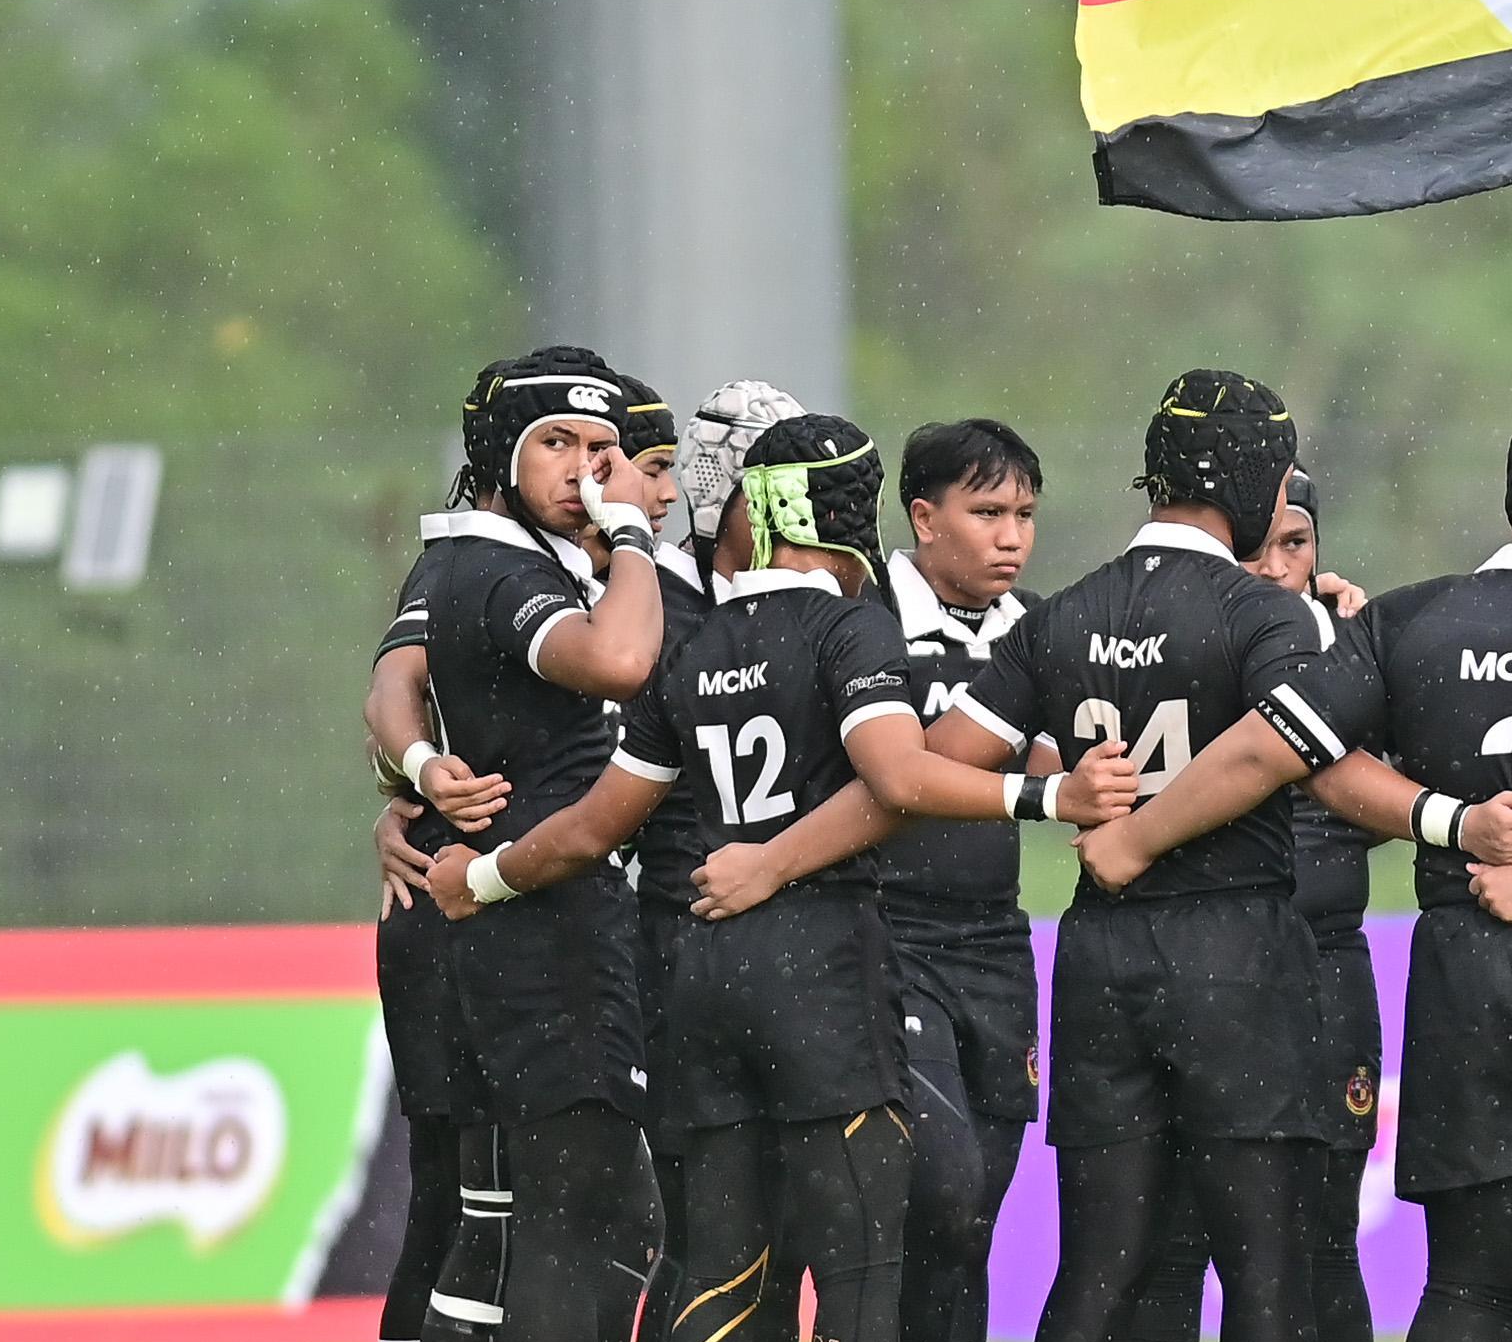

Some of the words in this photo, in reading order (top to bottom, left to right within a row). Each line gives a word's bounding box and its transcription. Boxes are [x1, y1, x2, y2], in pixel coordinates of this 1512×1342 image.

[1087, 632, 1168, 670] MCKK
[697, 661, 769, 697] MCKK
[1272, 713, 1311, 753] GILBERT
[695, 714, 797, 826] 12
[78, 1114, 253, 1187] MILO
